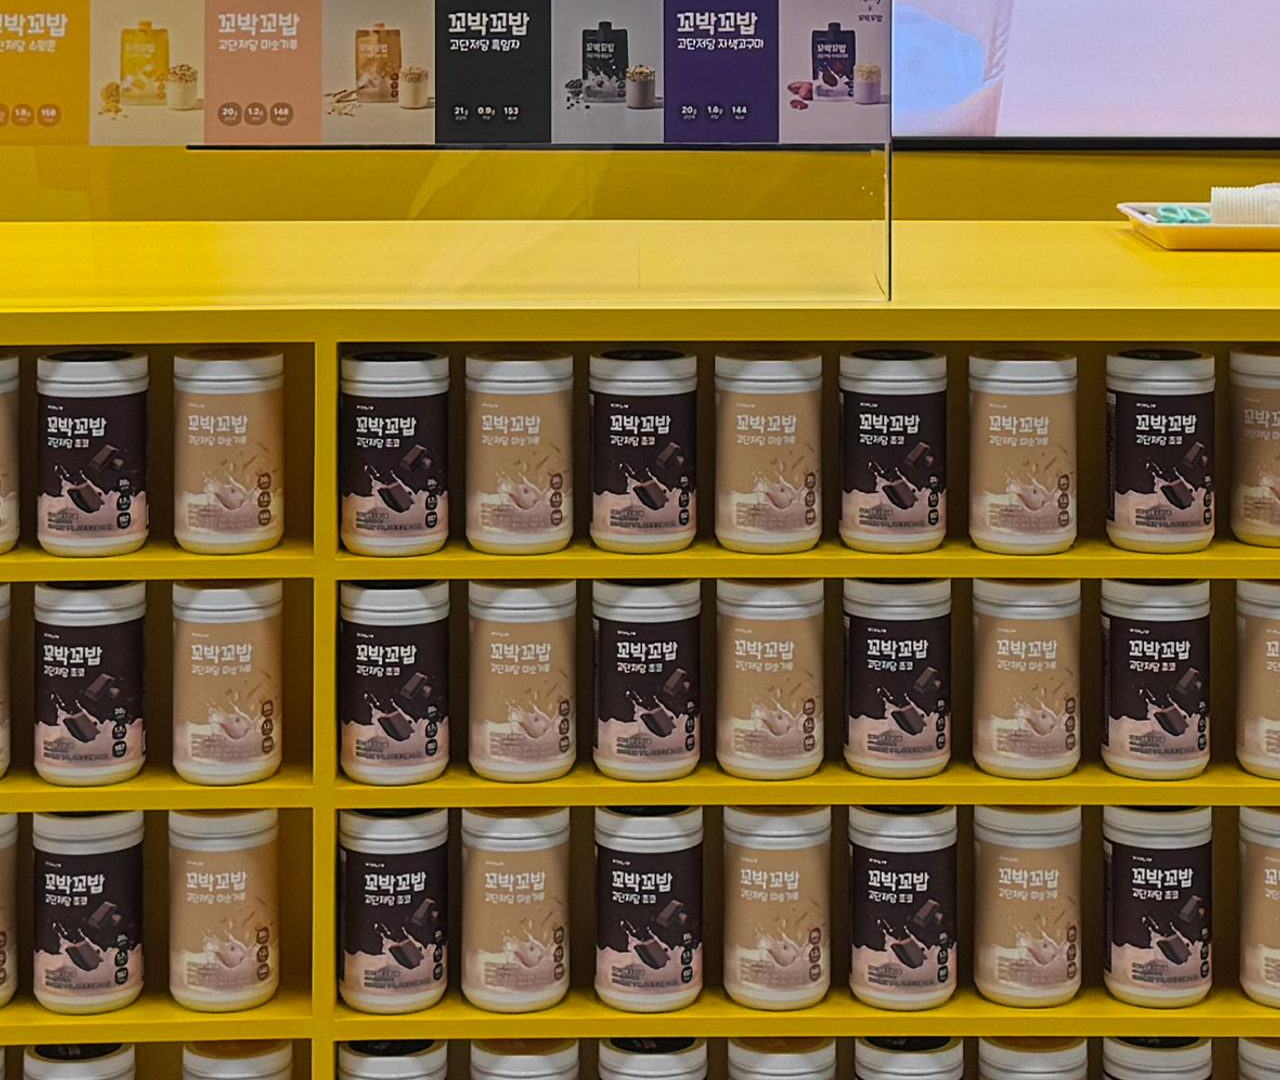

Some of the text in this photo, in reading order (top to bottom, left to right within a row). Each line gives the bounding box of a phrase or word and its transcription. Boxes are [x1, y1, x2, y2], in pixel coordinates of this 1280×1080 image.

[218, 13, 300, 36] 꼬박꼬밥
[448, 12, 530, 36] 꼬박꼬밥
[677, 12, 758, 36] 꼬박꼬밥
[218, 38, 259, 52] 고단저당
[450, 38, 490, 51] 고단저당
[677, 38, 715, 51] 고단저당
[47, 416, 108, 438] 꼬박꼬밥
[355, 415, 417, 437] 꼬박꼬밥
[610, 413, 672, 435] 꼬박꼬밥
[859, 413, 921, 435] 꼬박꼬밥
[1135, 413, 1198, 435] 꼬박꼬밥
[43, 644, 103, 666] 꼬박꼬밥
[355, 643, 417, 665] 꼬박꼬밥
[617, 641, 679, 663] 꼬박꼬밥
[867, 639, 929, 661] 꼬박꼬밥
[1129, 640, 1191, 661] 꼬박꼬밥
[44, 873, 105, 895] 꼬박꼬밥
[364, 870, 426, 893] 꼬박꼬밥
[612, 870, 673, 893] 꼬박꼬밥
[868, 869, 929, 892] 꼬박꼬밥
[1131, 867, 1194, 889] 꼬박꼬밥
